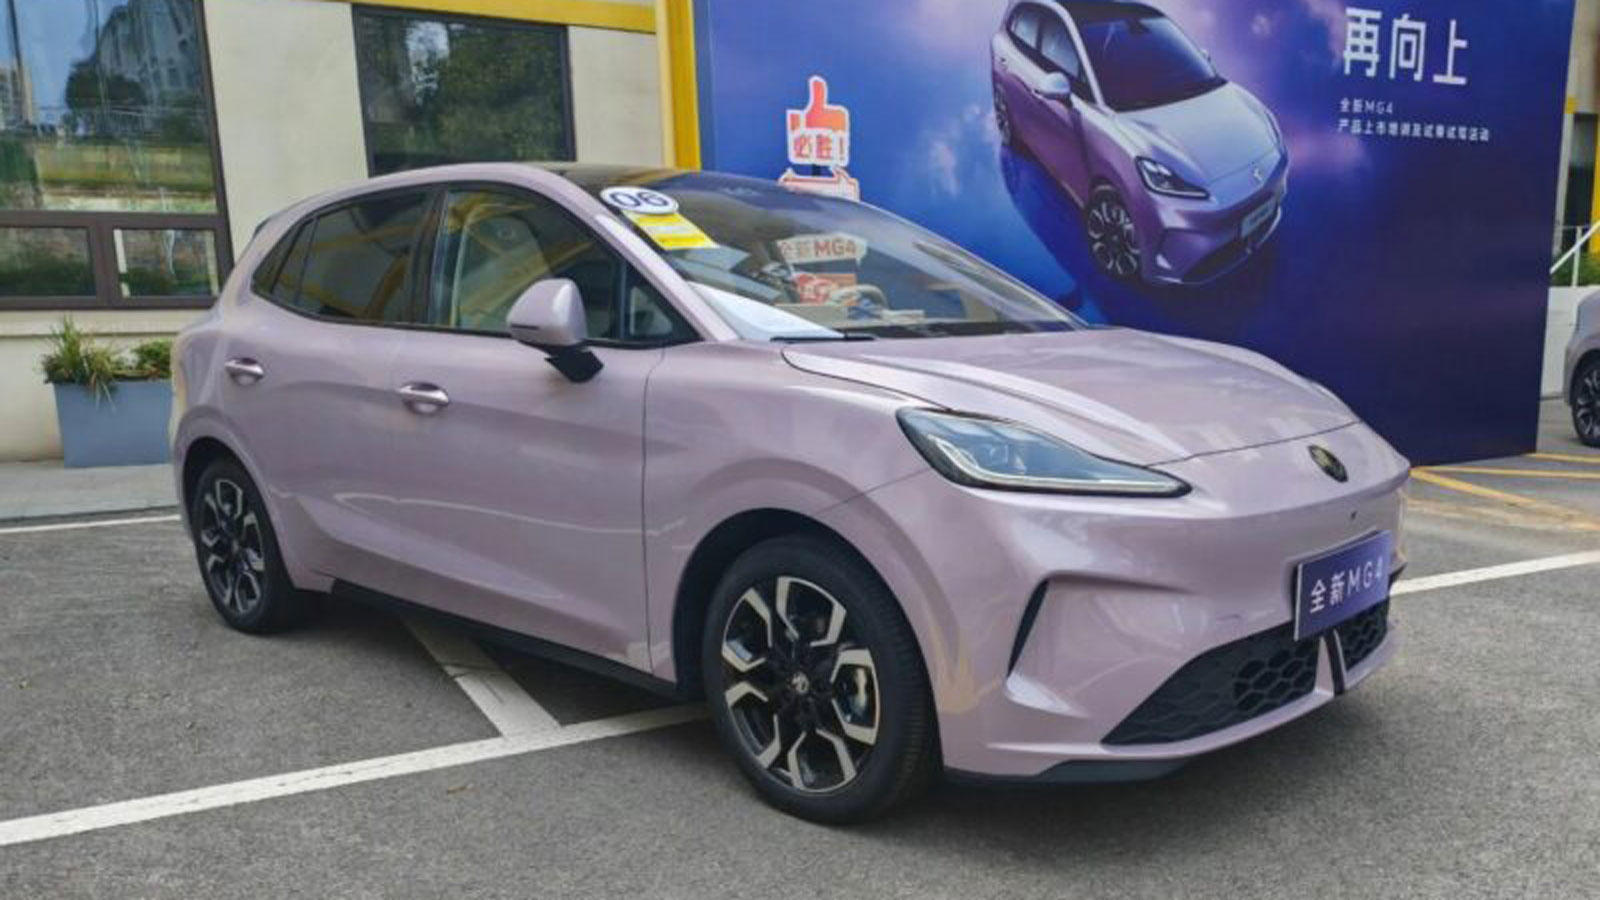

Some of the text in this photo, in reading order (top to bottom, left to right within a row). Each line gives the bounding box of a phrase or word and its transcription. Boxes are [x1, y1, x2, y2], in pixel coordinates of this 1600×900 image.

[1343, 7, 1468, 85] 再向上
[1340, 98, 1393, 114] 全新MG4
[609, 192, 669, 208] 06
[1310, 556, 1384, 614] 全新MG4
